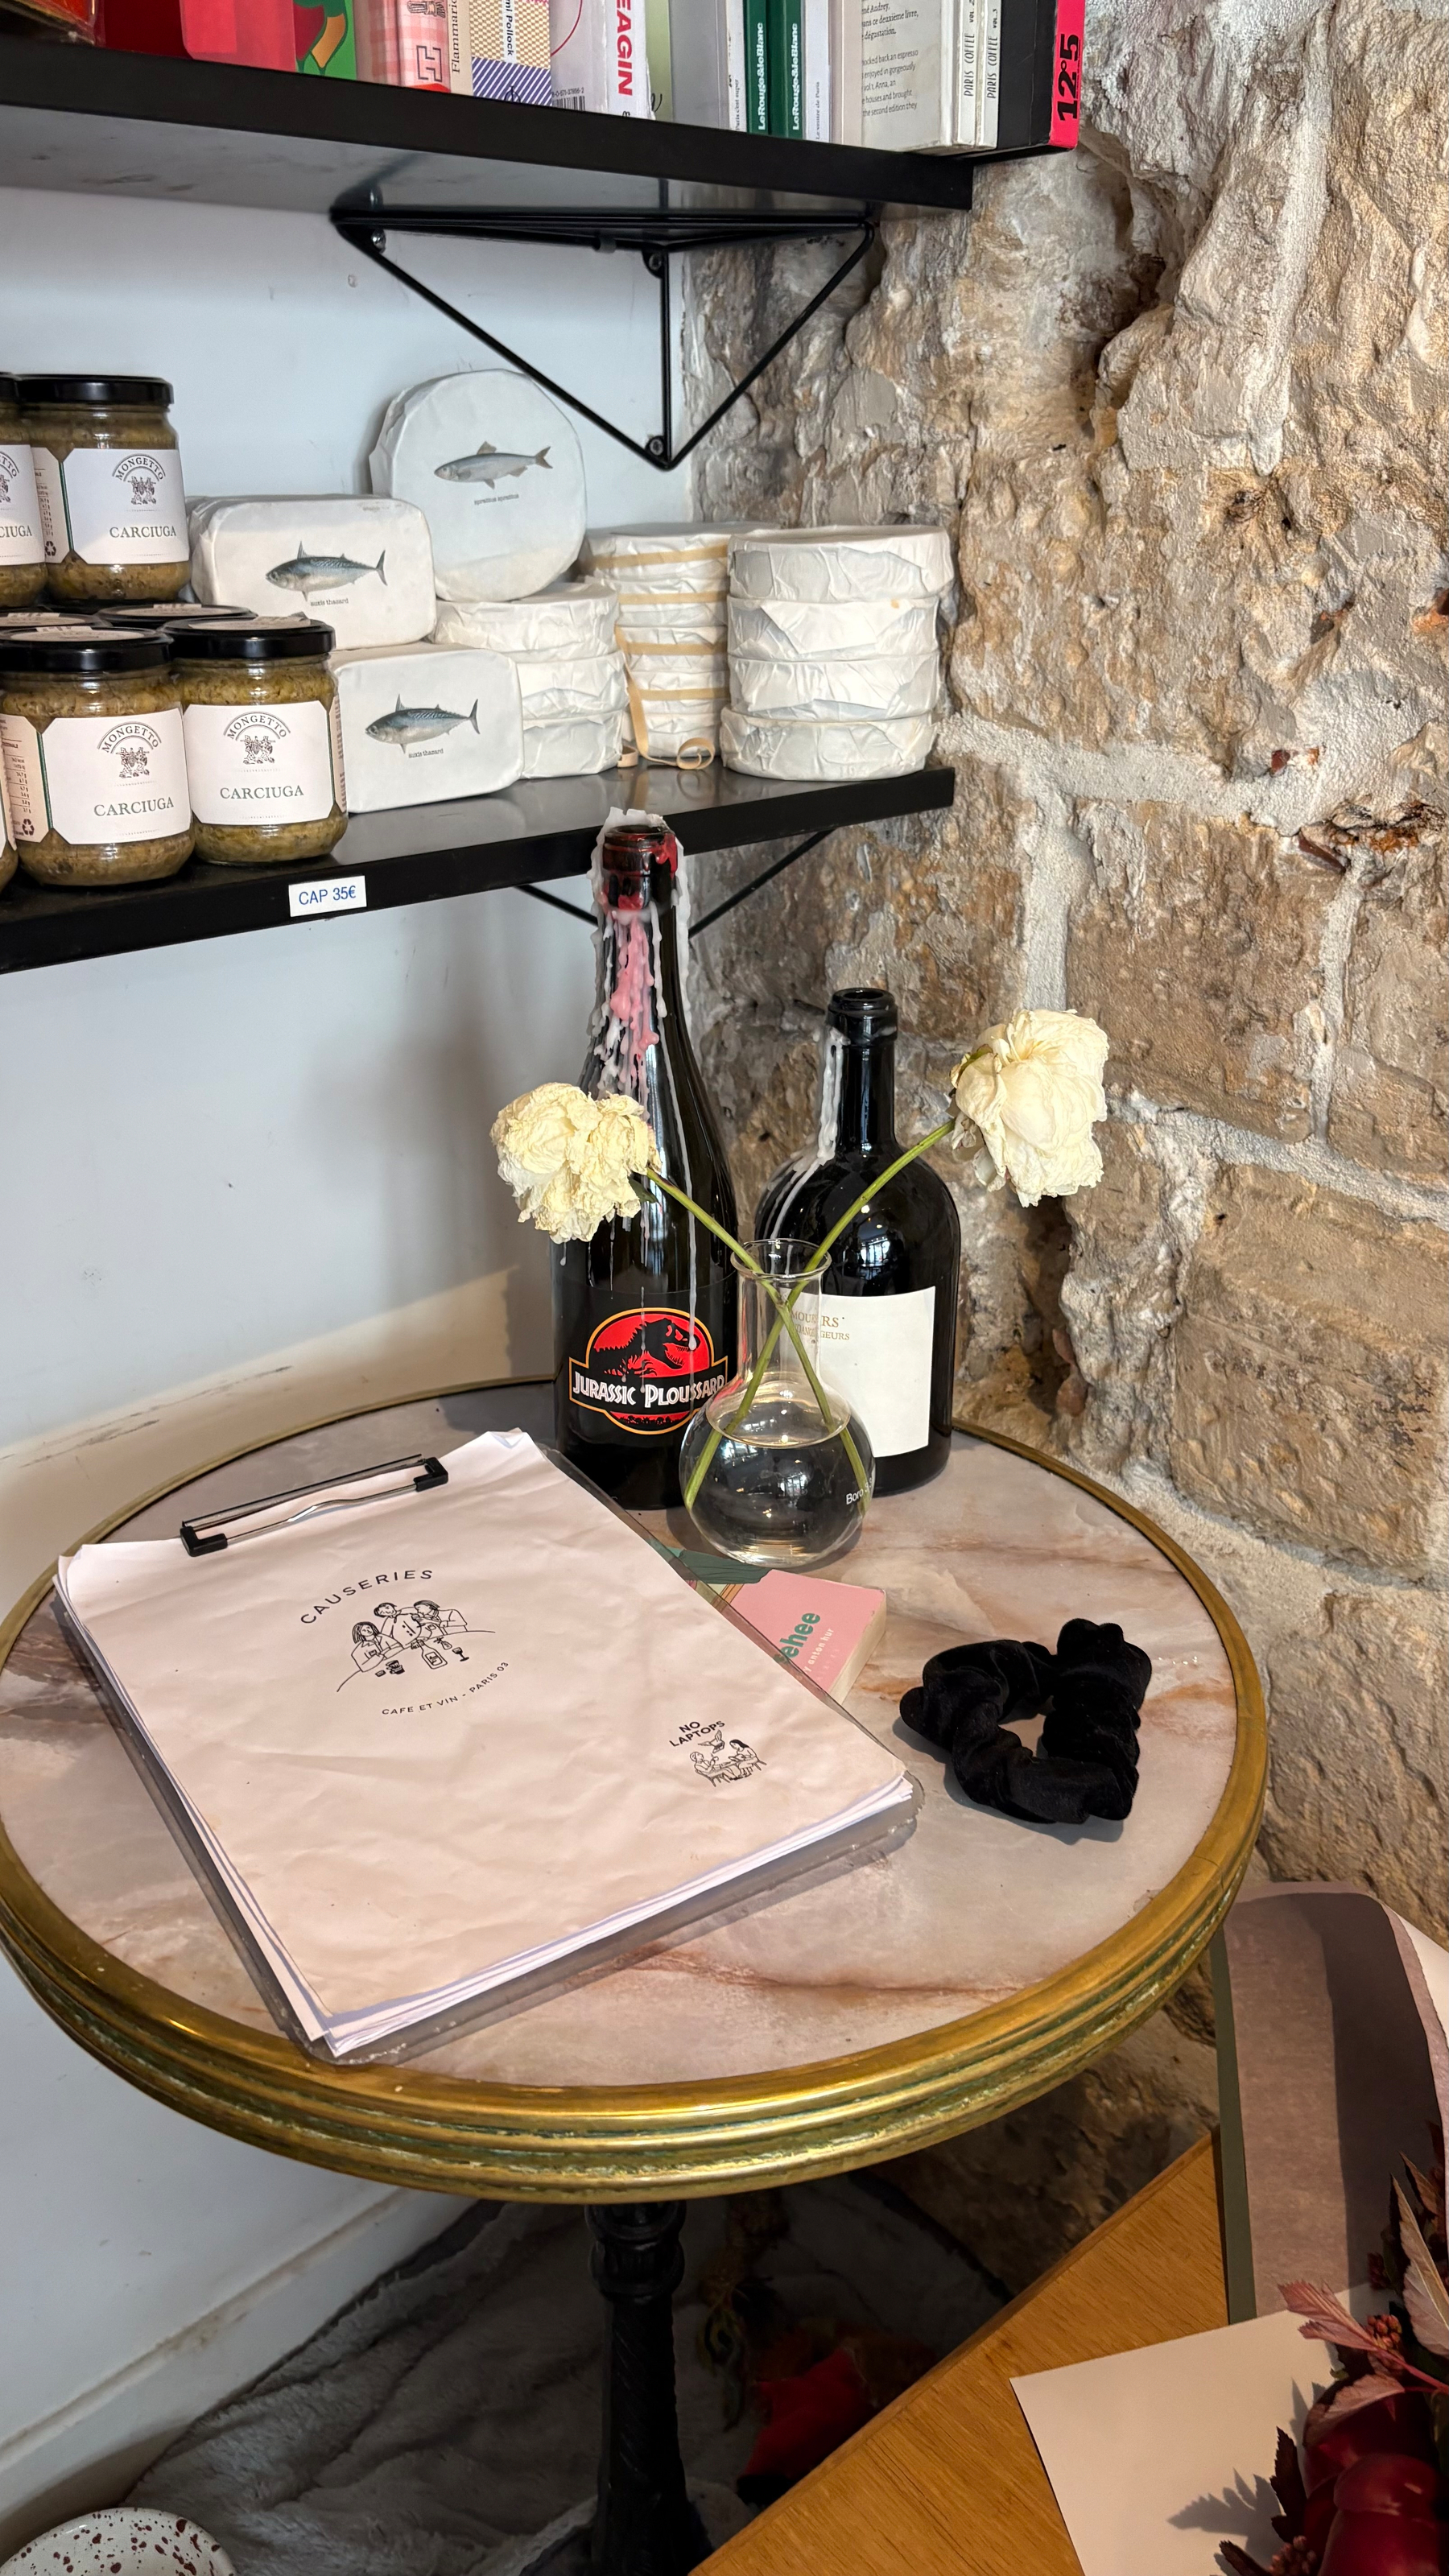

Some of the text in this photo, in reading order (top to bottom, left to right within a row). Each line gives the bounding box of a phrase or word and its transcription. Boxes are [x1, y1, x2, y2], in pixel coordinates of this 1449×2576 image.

[506, 14, 514, 56] Pollock
[898, 49, 919, 60] espresso
[964, 33, 975, 64] COFFEE
[988, 36, 997, 66] COFFEE
[964, 71, 974, 97] PARIS
[987, 72, 997, 98] PARIS
[115, 456, 163, 481] MONGETTO
[109, 526, 176, 539] CARCIUGA
[101, 725, 159, 753] MONGETTO
[227, 715, 287, 740] MONGETTO
[220, 785, 304, 799] CARCIUGA
[93, 797, 175, 817] CARCIUGA
[299, 885, 357, 906] CAP 35€
[572, 1371, 724, 1408] JURASSIC PLOUSSARD
[846, 1488, 864, 1505] Boro
[300, 1570, 433, 1624] CAUSERIES
[807, 1642, 826, 1665] anton
[820, 1628, 834, 1641] hur
[382, 1706, 414, 1715] CAFE
[419, 1703, 433, 1711] ET
[437, 1695, 458, 1707] VIN
[469, 1673, 497, 1694] PARIS
[497, 1662, 509, 1672] 03
[669, 1720, 725, 1747] LAPTOPS
[679, 1721, 700, 1733] NO
